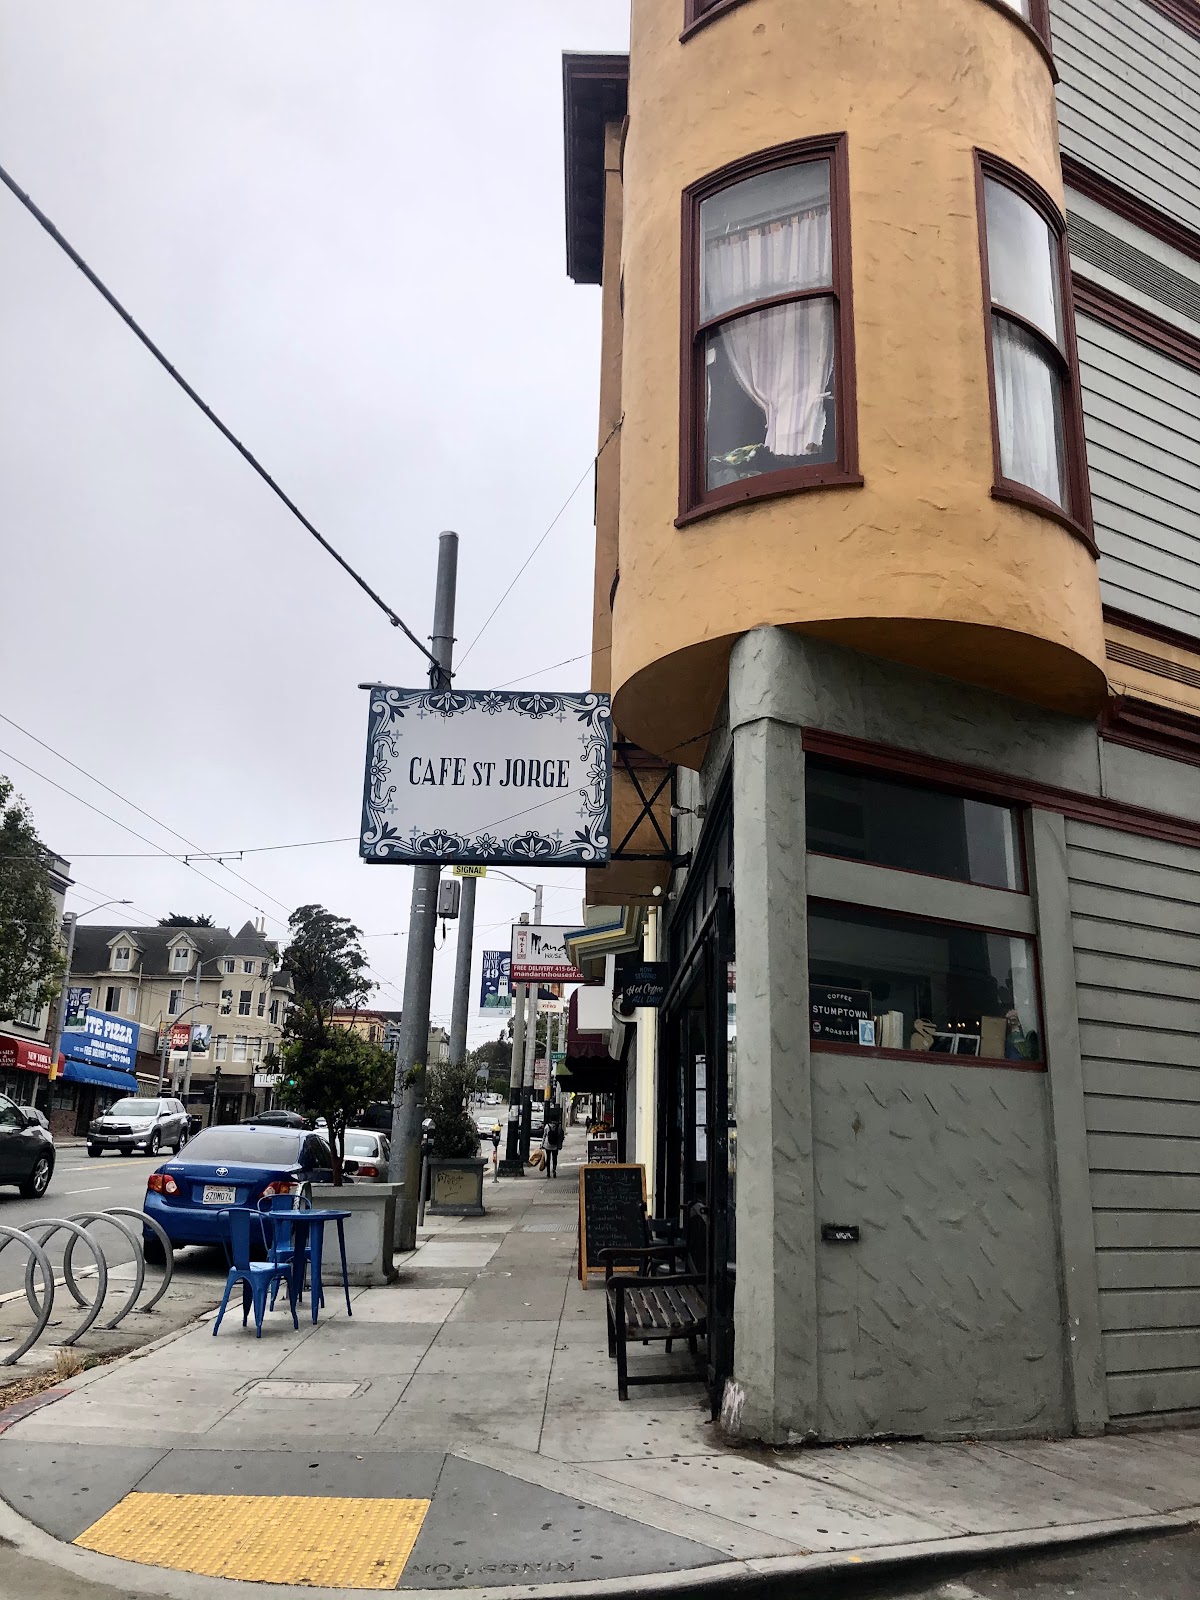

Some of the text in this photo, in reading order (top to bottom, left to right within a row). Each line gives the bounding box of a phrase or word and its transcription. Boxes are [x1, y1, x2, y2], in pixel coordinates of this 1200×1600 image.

[409, 756, 570, 787] CAFE ST JORGE
[456, 865, 483, 874] SIGNAL
[482, 968, 499, 978] 49
[827, 993, 853, 1002] COFFEE
[812, 1005, 868, 1019] STUMPTOWN
[103, 1021, 133, 1045] PIZZA
[825, 1026, 858, 1036] ROASTERS
[28, 1051, 37, 1060] NEW
[37, 1053, 48, 1064] YORK
